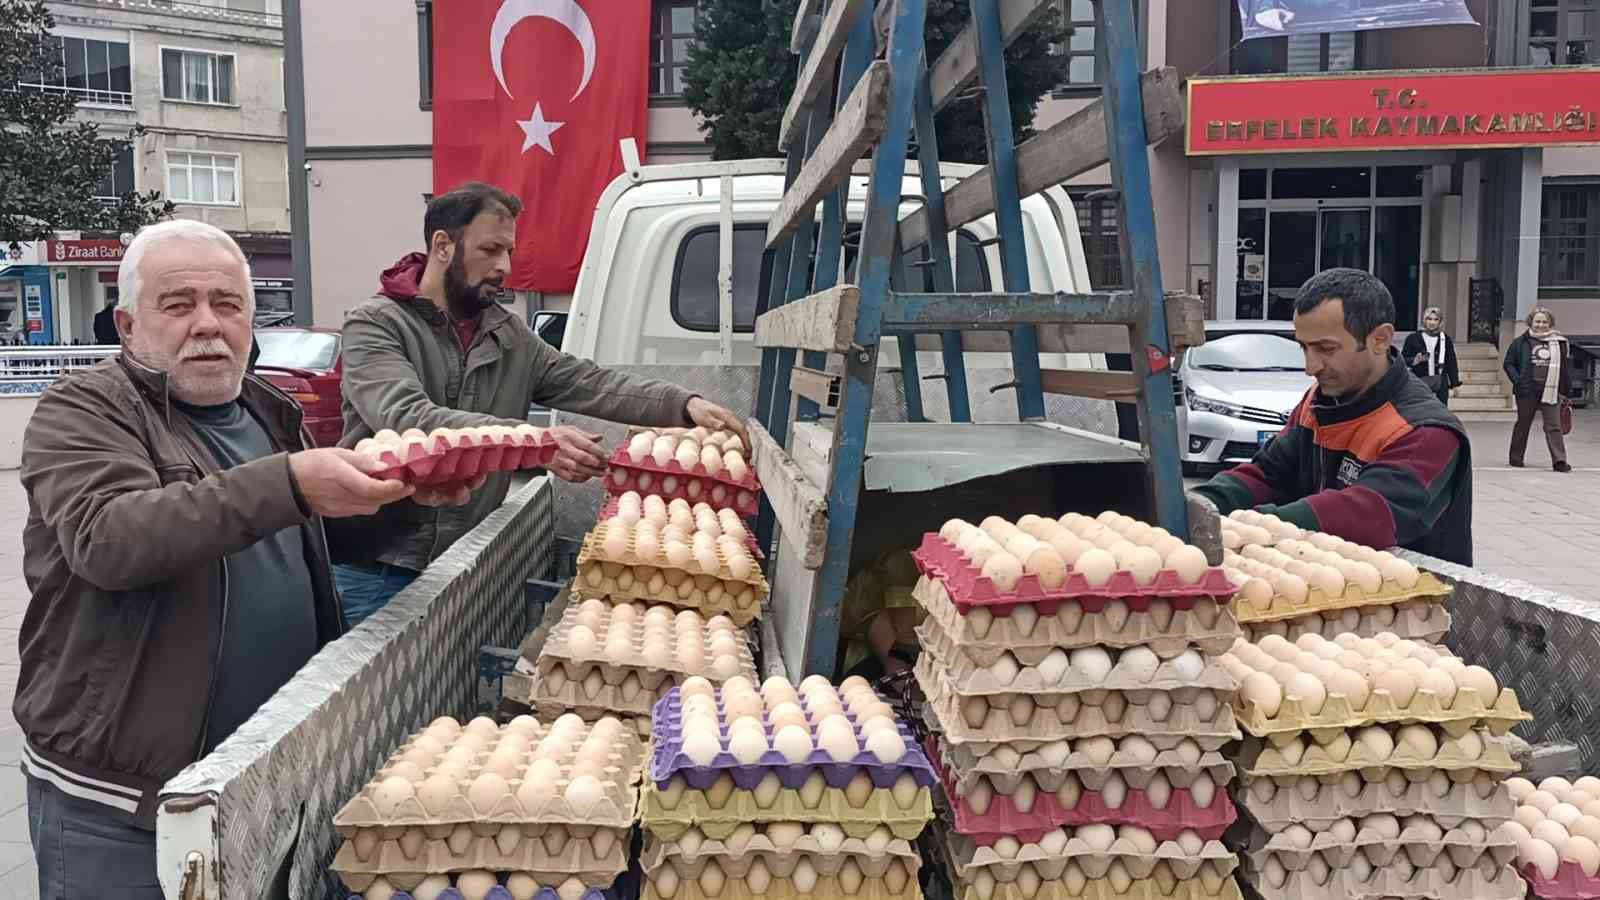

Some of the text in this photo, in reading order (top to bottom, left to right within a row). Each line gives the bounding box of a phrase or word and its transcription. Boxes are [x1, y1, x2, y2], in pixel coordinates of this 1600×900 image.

[1370, 88, 1428, 110] T.C.
[1205, 104, 1597, 141] ERFELEK KAYMAKAMLIĞI
[67, 245, 98, 258] Ziraat
